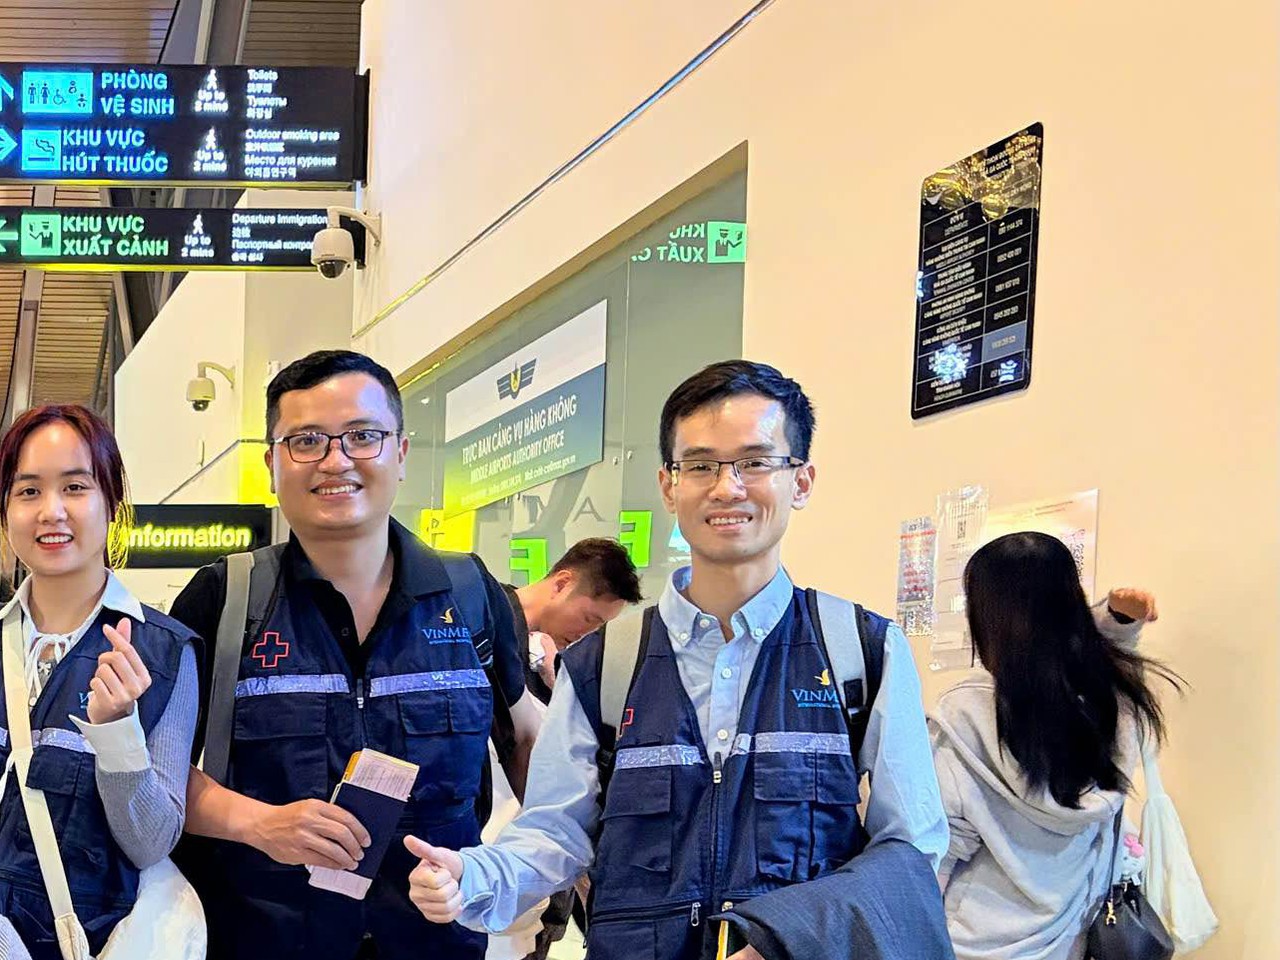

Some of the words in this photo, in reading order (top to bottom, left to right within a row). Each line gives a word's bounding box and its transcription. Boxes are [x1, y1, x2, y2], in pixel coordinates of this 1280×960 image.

[101, 69, 168, 90] PHÒNG
[247, 69, 278, 80] Toilets
[198, 90, 213, 102] Up
[214, 91, 226, 101] to
[100, 94, 125, 117] VỆ
[130, 97, 175, 115] SINH
[203, 101, 229, 112] mins
[63, 129, 102, 146] KHU
[105, 127, 145, 149] VỰC
[245, 128, 281, 139] Outdoor
[282, 129, 318, 142] smoking
[319, 132, 340, 141] area
[62, 151, 100, 173] HÚT
[103, 149, 168, 173] THUỐC
[197, 150, 211, 162] Up
[212, 151, 224, 161] to
[202, 161, 227, 172] mins
[63, 216, 102, 232] KHU
[106, 214, 145, 236] VỰC
[232, 213, 276, 225] Departure
[63, 233, 114, 256] XUẤT
[116, 234, 169, 256] CẢNH
[184, 235, 199, 246] Up
[200, 236, 211, 245] to
[283, 241, 314, 251] контро
[181, 248, 189, 257] 2
[190, 247, 214, 257] mins
[523, 409, 547, 437] HÀNG
[547, 394, 577, 427] KHÔNG
[543, 429, 565, 455] OFFICE
[129, 522, 253, 547] nformation
[421, 627, 470, 639] VINME
[790, 688, 840, 702] VINM
